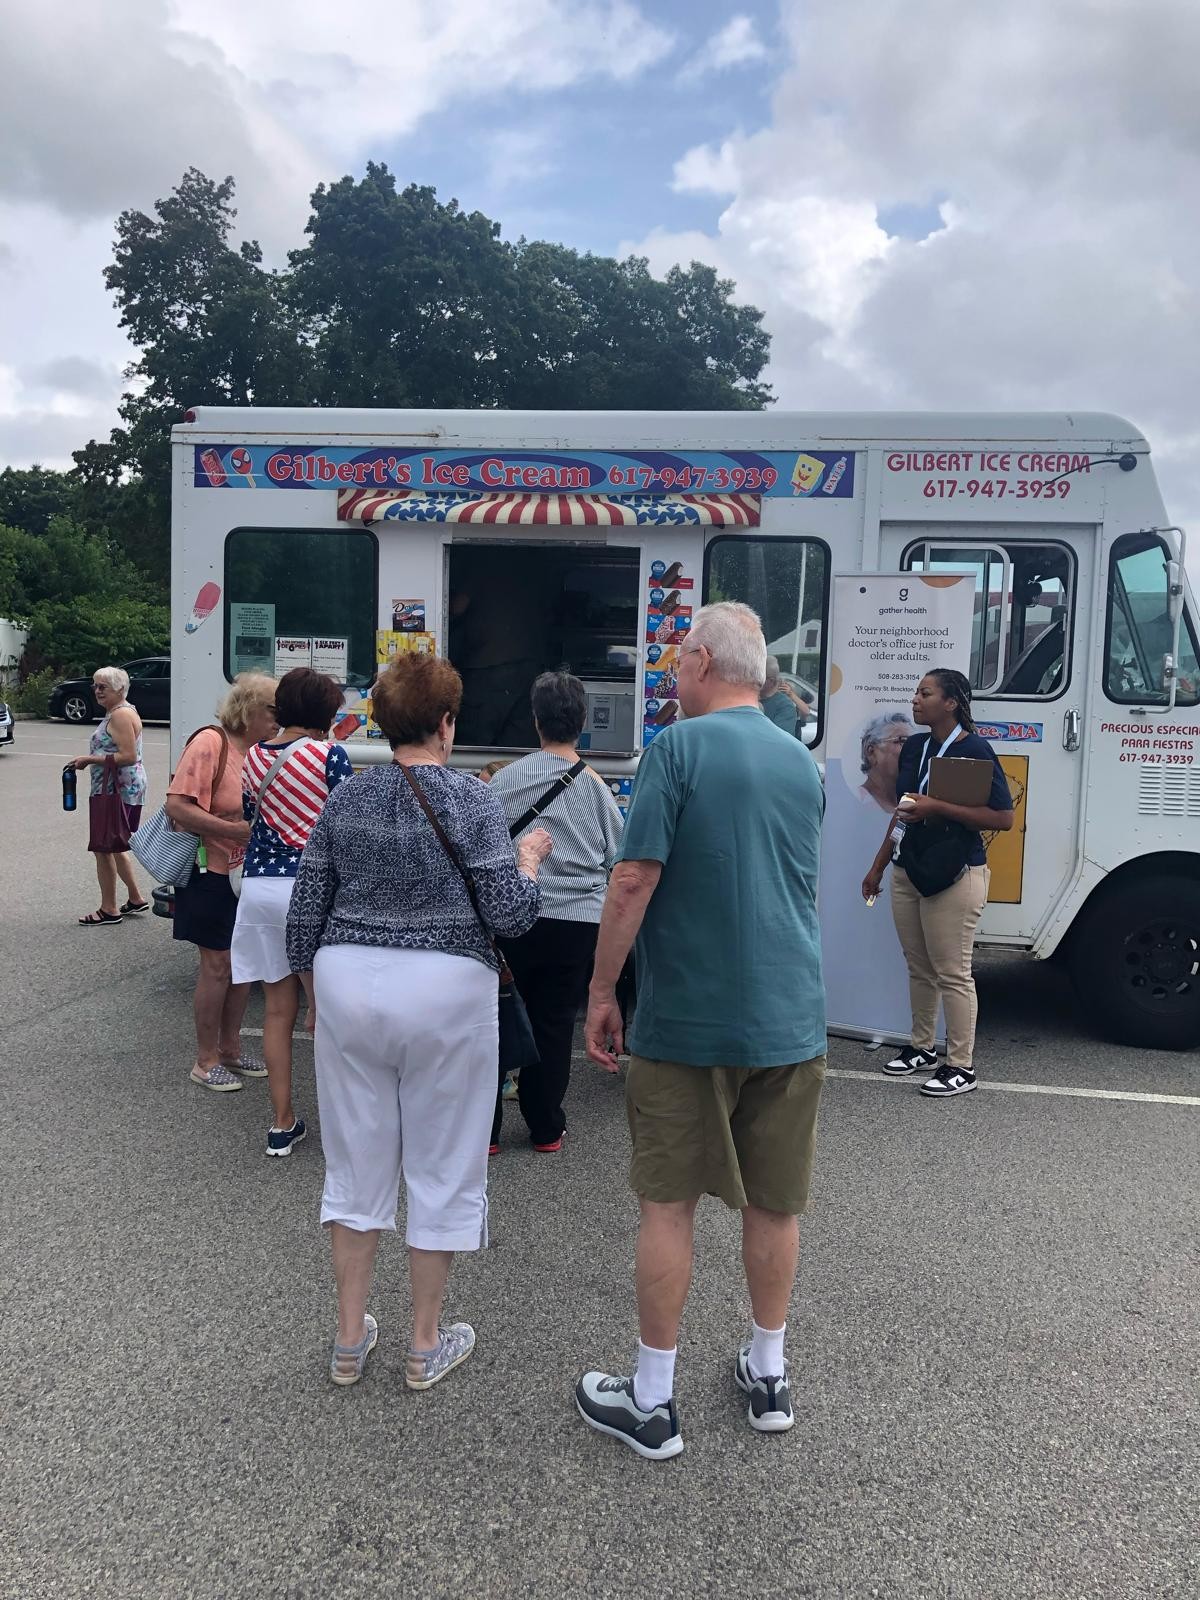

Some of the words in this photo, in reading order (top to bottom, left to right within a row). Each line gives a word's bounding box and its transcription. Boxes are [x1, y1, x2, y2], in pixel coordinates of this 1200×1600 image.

[887, 453, 974, 473] GILBERT
[980, 454, 1011, 473] ICE
[1017, 455, 1091, 473] CREAM
[267, 454, 411, 483] Gilbert's
[422, 457, 470, 486] Ice
[480, 459, 591, 488] Cream
[608, 466, 778, 489] 617-947-3939
[825, 463, 845, 491] WATER
[923, 479, 1071, 498] 617-947-3939
[878, 606, 903, 615] gather
[855, 625, 879, 635] Your
[879, 626, 949, 637] neighborhood
[848, 638, 888, 648] doctor's
[889, 638, 917, 649] office
[918, 640, 937, 650] just
[939, 640, 955, 650] for
[870, 651, 896, 660] older
[897, 651, 930, 661] adults.
[1007, 724, 1039, 739] MA
[1101, 723, 1154, 734] PRECIOUS
[1156, 725, 1200, 736] ESPECIA
[1121, 738, 1151, 749] PARA
[1153, 740, 1194, 750] FIESTAS
[1119, 753, 1194, 765] 617-947-3939
